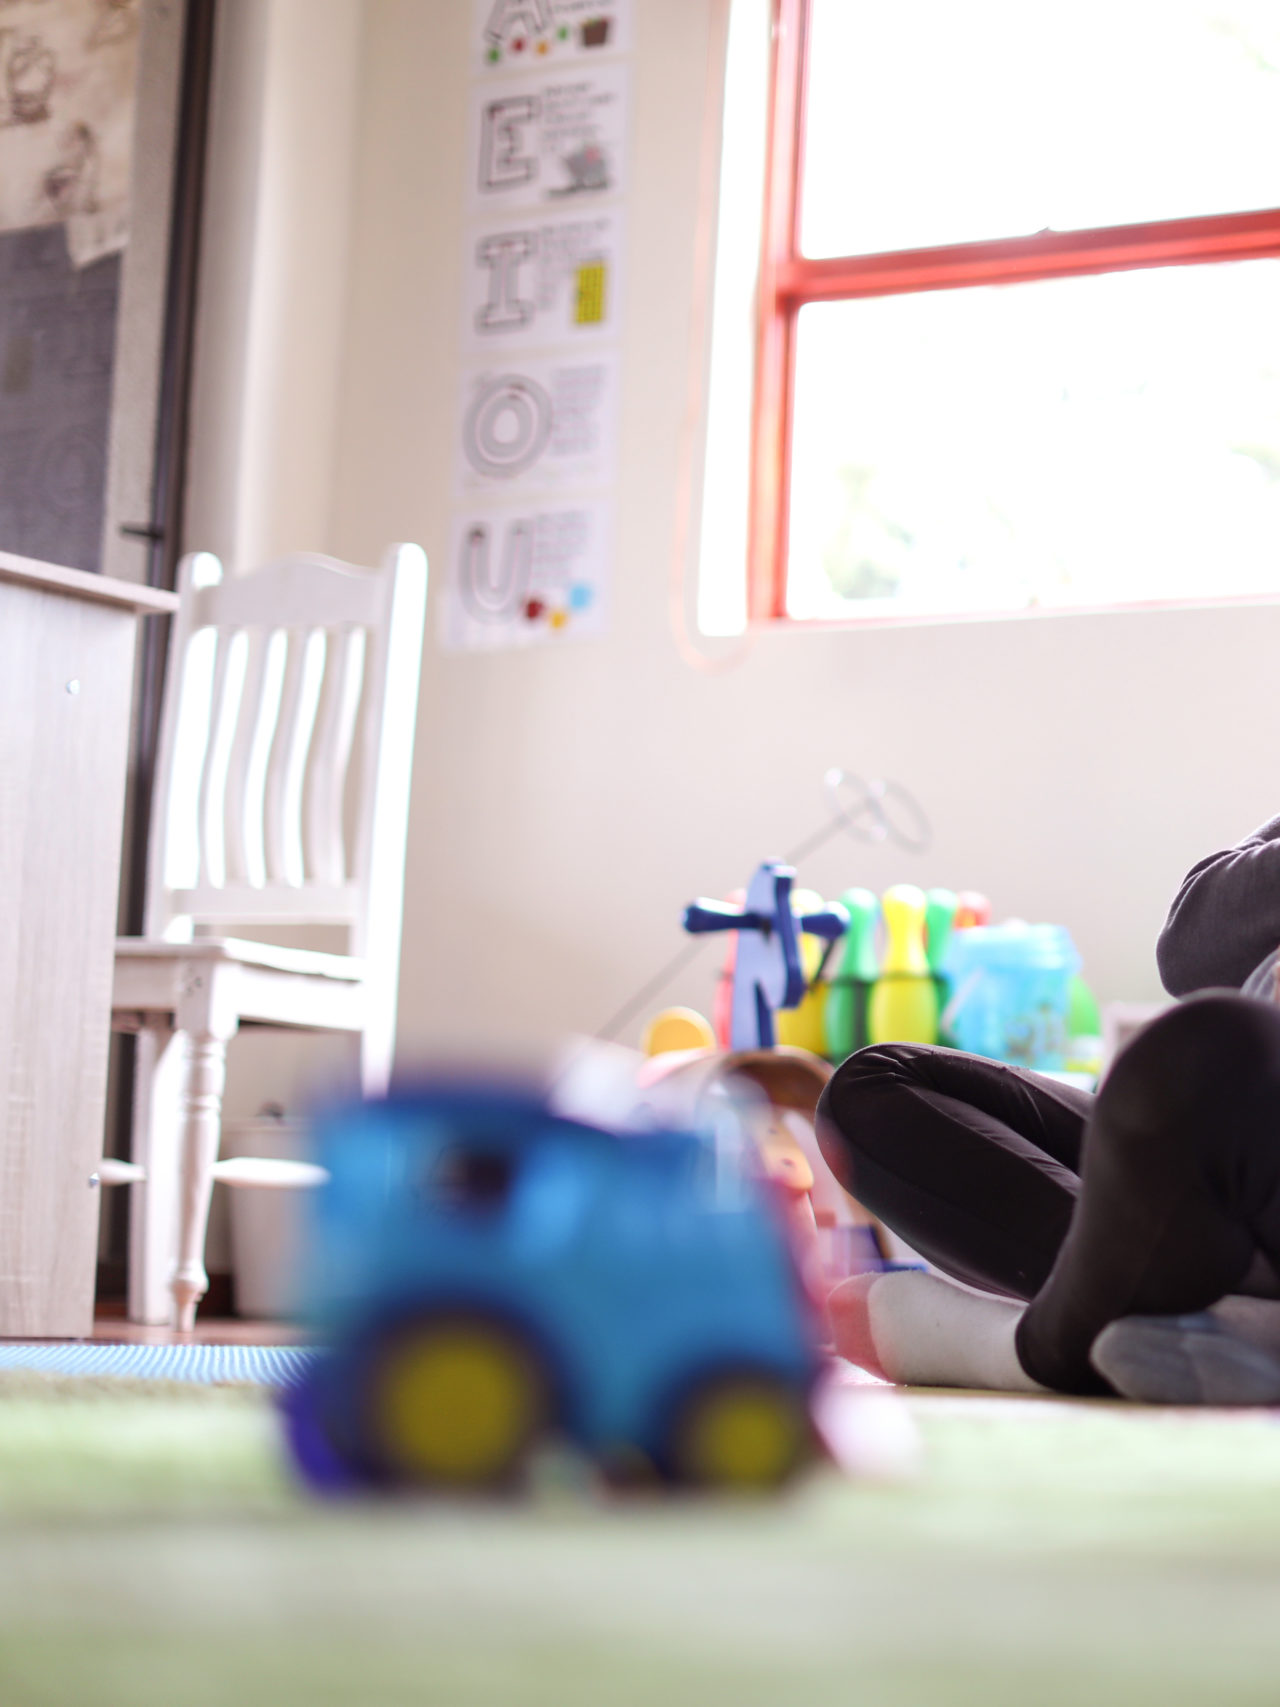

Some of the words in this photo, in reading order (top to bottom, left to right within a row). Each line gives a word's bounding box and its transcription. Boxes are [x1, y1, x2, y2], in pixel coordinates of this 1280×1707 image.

[478, 94, 541, 196] E
[473, 231, 539, 337] I
[462, 372, 553, 481] O
[457, 517, 535, 627] U
